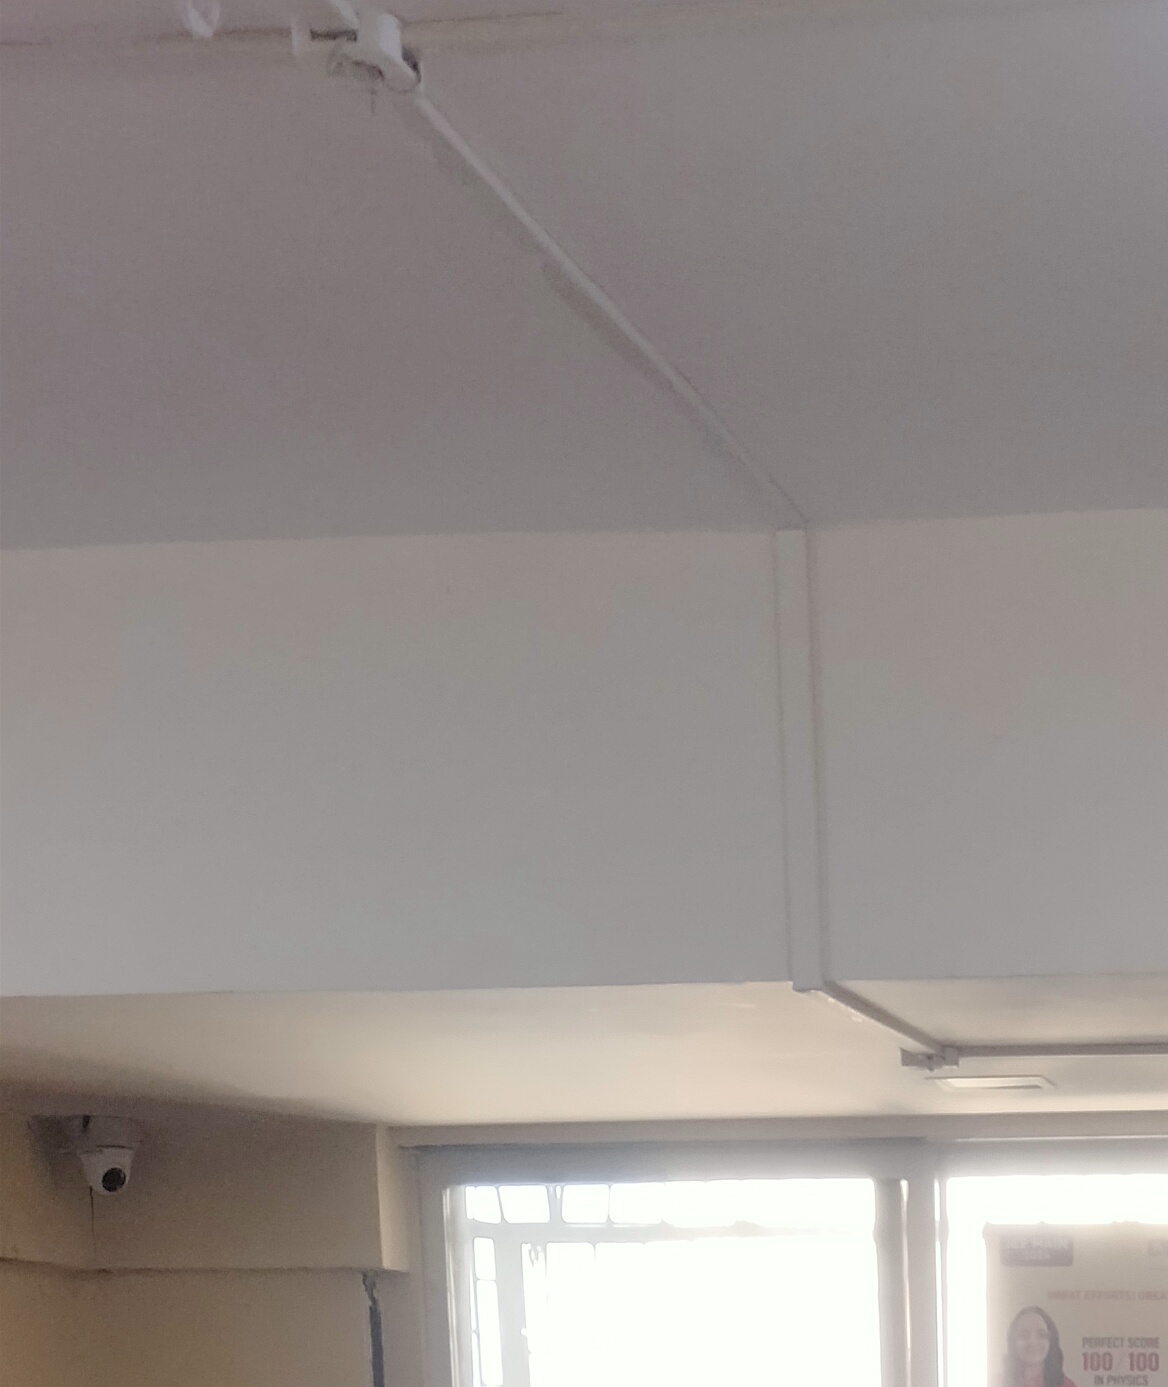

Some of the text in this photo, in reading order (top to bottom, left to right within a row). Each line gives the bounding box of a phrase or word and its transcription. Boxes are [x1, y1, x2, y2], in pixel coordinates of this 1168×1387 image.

[1082, 1336, 1160, 1348] PERFECT SCORE
[1081, 1351, 1113, 1372] 100
[1128, 1351, 1160, 1372] 100
[1093, 1374, 1149, 1387] IN PHYSICS
